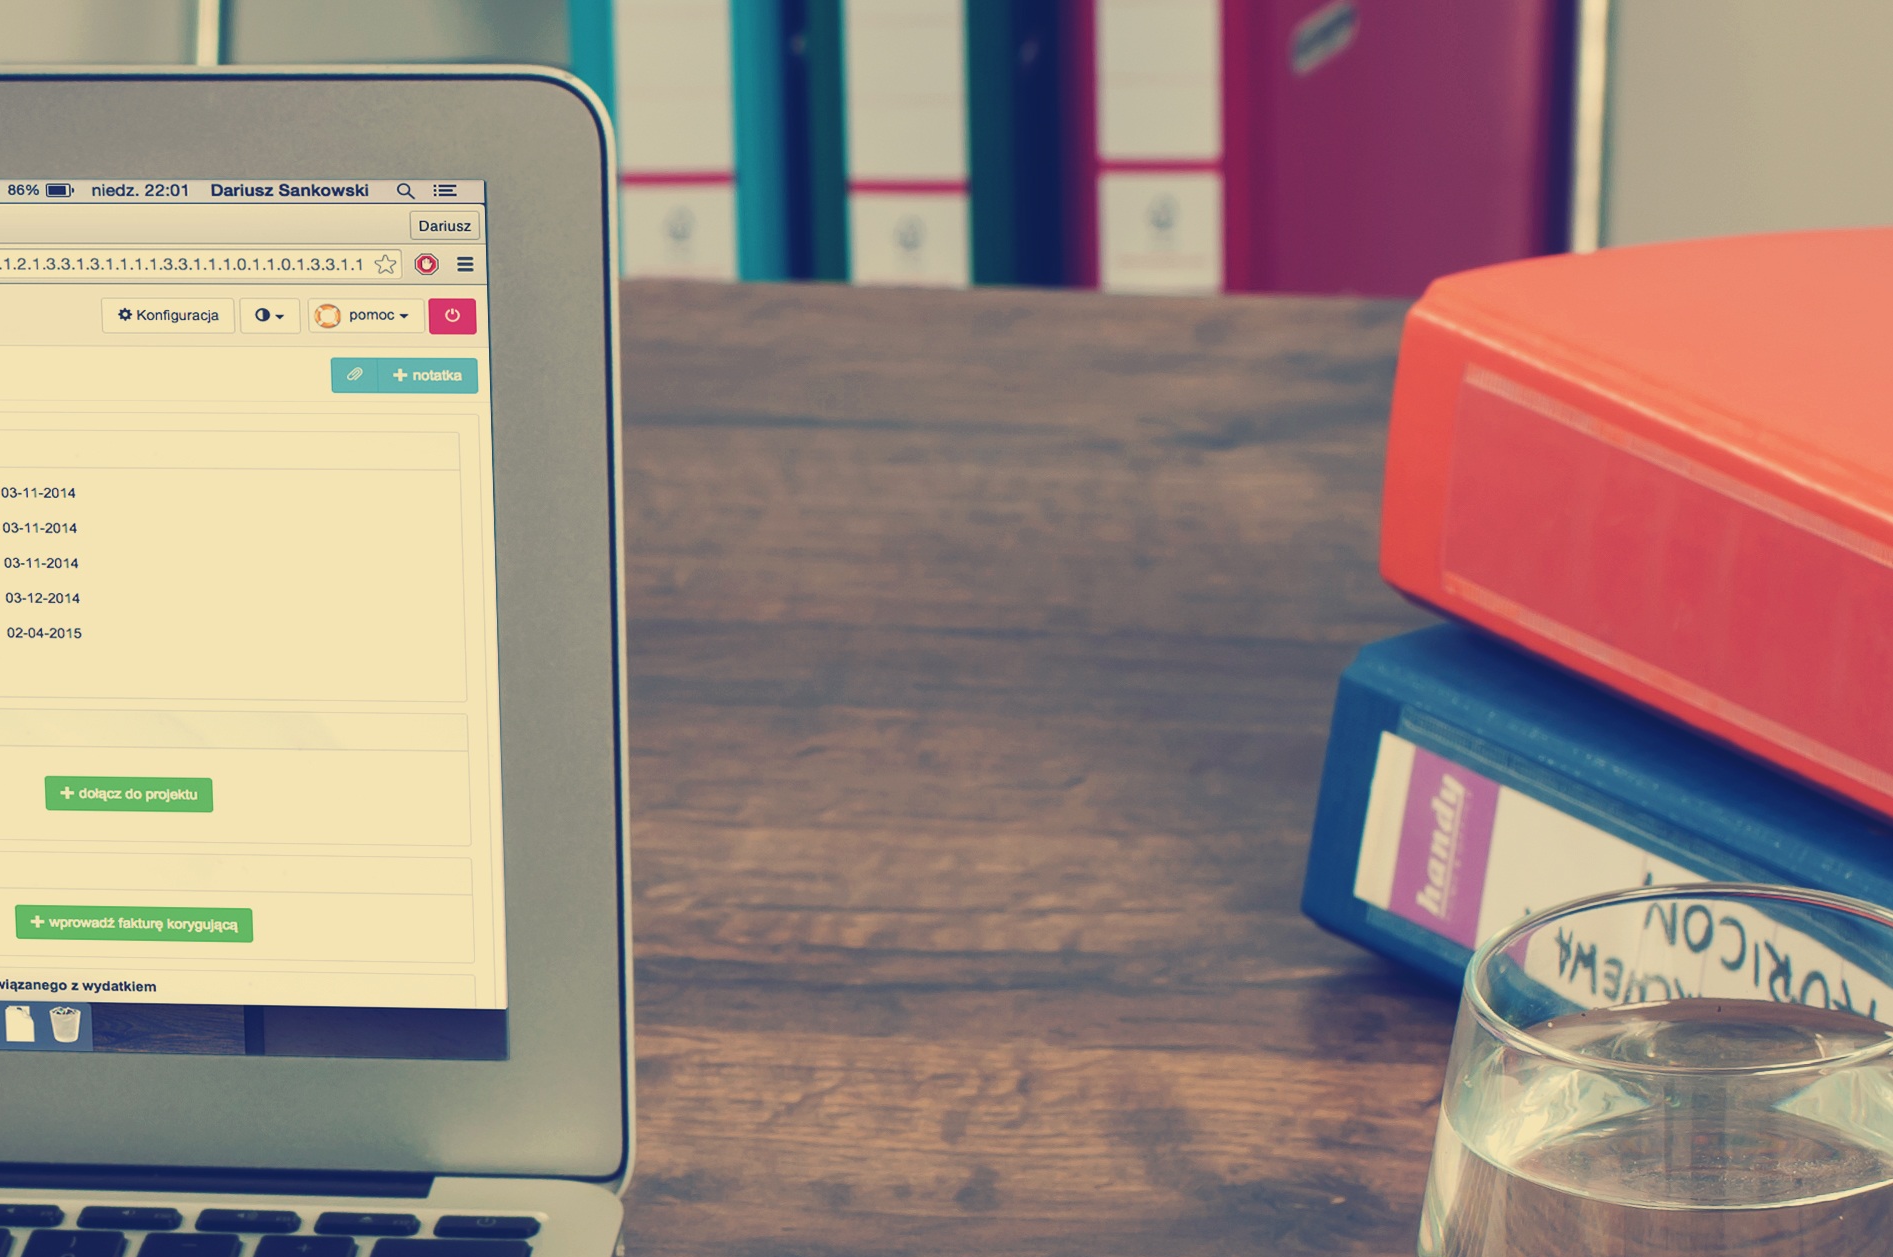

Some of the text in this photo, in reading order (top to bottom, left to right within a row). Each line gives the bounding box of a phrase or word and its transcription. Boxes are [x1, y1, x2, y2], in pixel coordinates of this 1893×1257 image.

[7, 183, 369, 197] 86% niedz. 22:01 Dariusz Sankowski
[418, 220, 472, 232] Dariusz
[136, 309, 220, 324] Konfiguracja
[349, 310, 395, 323] pomoc
[412, 369, 463, 382] notatka
[0, 486, 76, 499] 03-11-2014
[2, 521, 78, 534] 03-11-2014
[3, 556, 79, 569] 03-11-2014
[5, 591, 81, 604] 03-12-2014
[6, 626, 83, 640] 02-04-2015
[78, 787, 198, 803] dołącz do projektu
[1417, 774, 1466, 917] handy
[48, 916, 239, 934] wprowadź fakturę korygującą
[70, 982, 80, 991] z
[81, 980, 157, 994] wydatkiem
